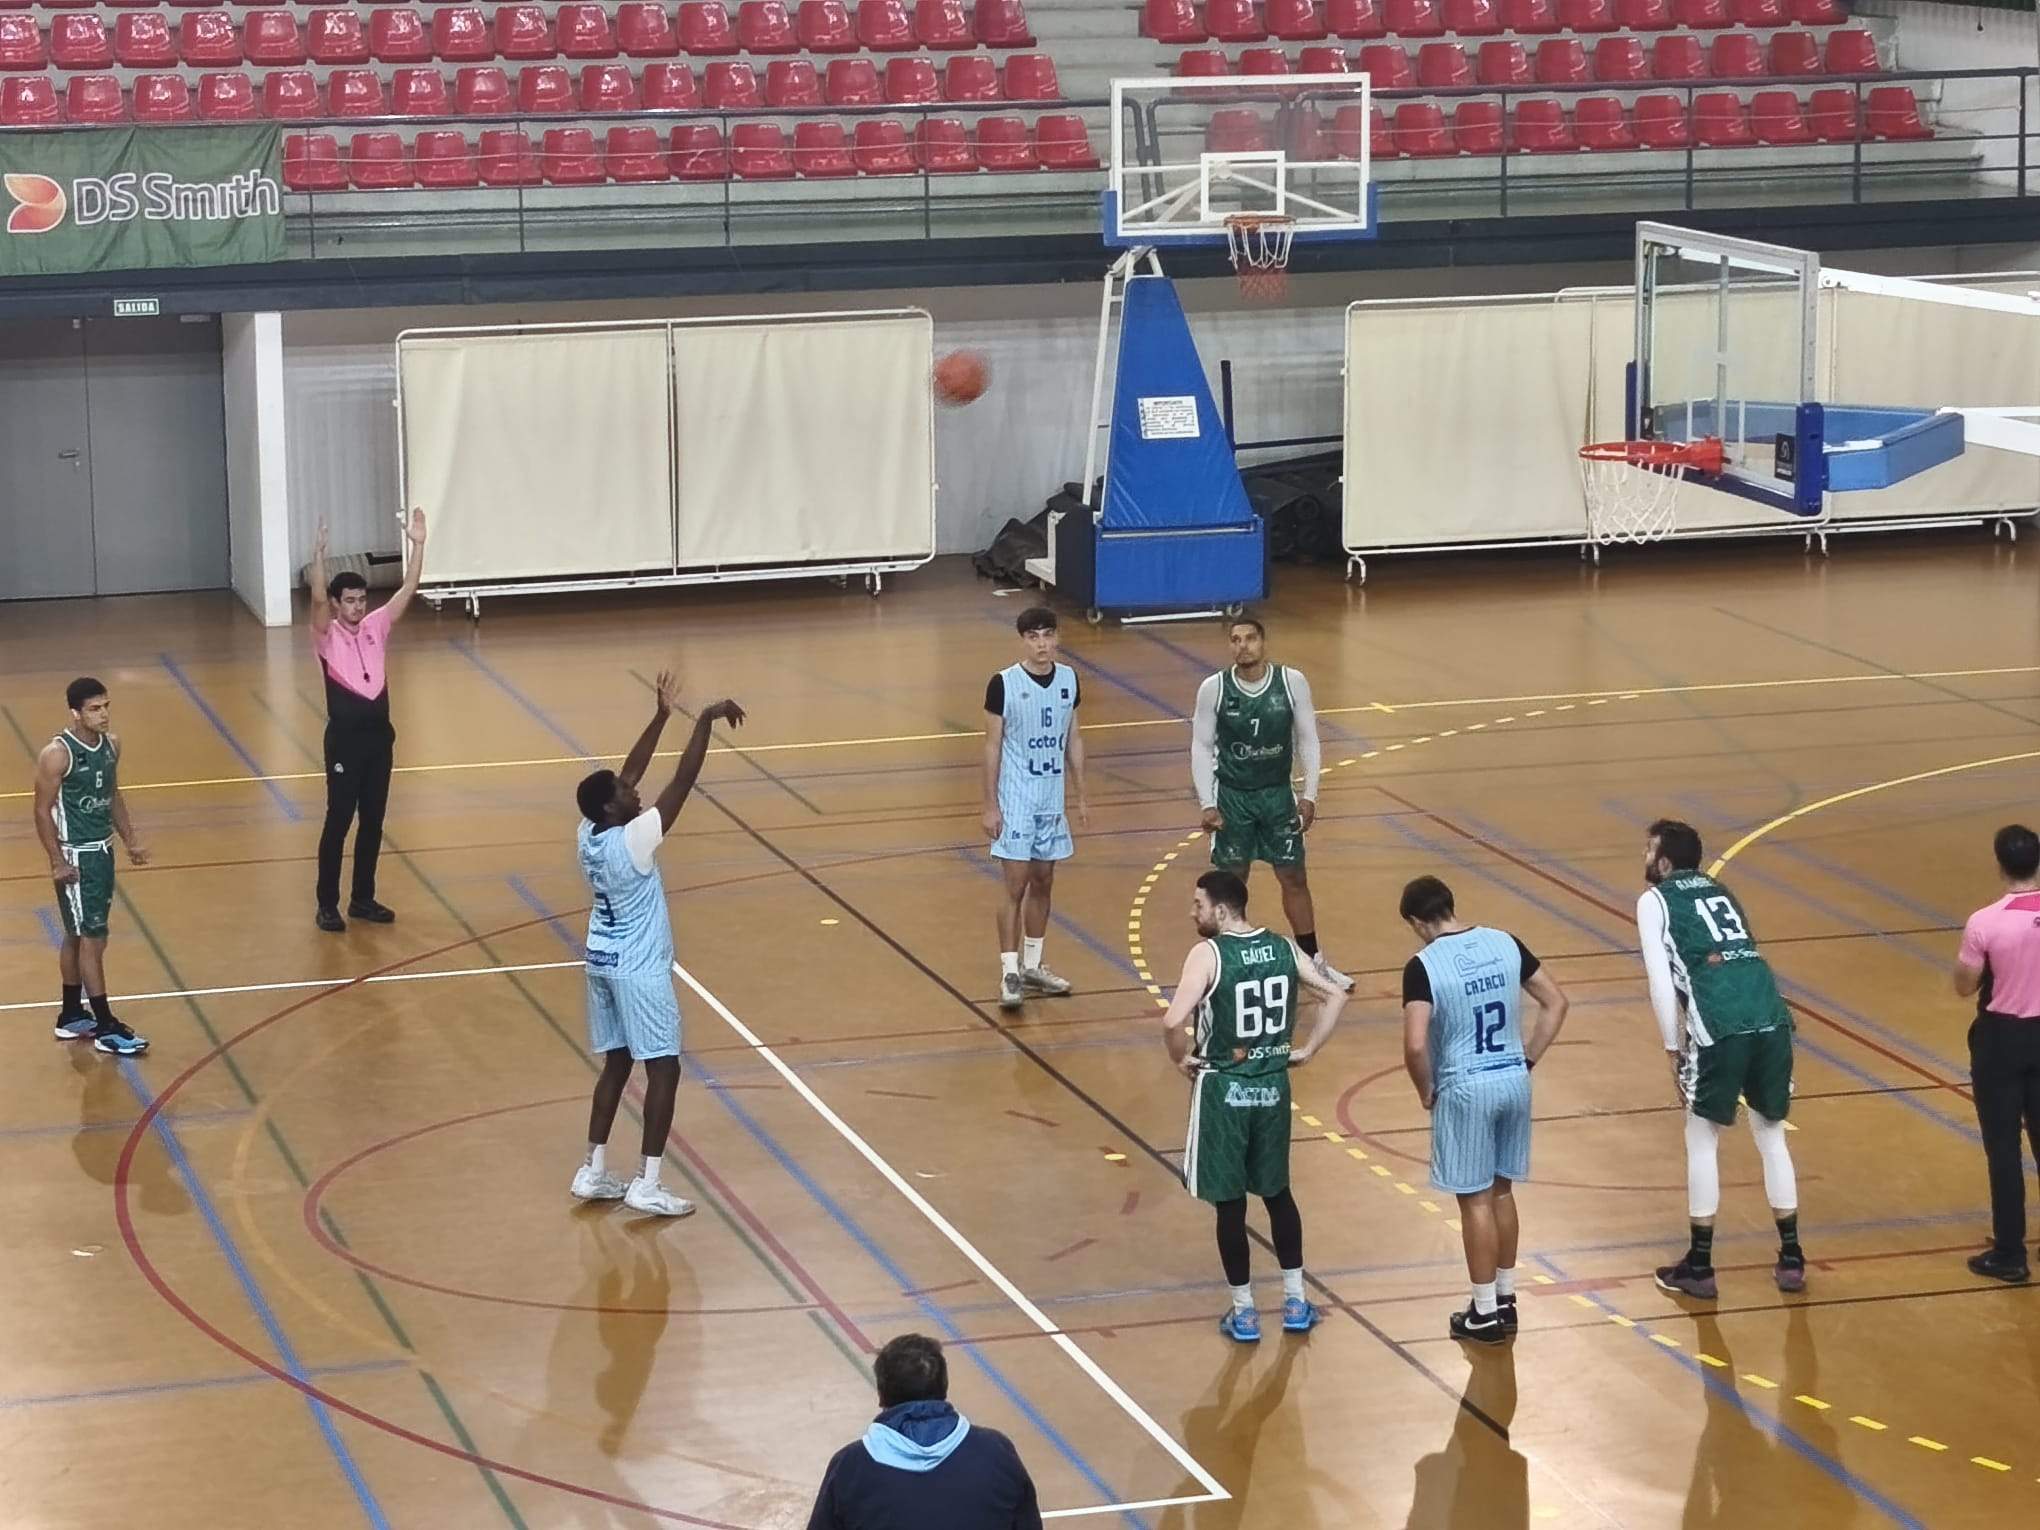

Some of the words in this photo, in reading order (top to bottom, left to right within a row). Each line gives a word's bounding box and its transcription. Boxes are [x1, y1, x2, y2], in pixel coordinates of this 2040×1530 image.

[73, 172, 139, 225] DS
[142, 169, 280, 221] Smith
[117, 302, 156, 313] SALIDA
[1041, 707, 1053, 728] 16
[1250, 718, 1260, 737] 7
[1284, 839, 1294, 853] 7
[1694, 895, 1749, 942] 13
[1464, 973, 1506, 997] CAZACU
[1235, 975, 1289, 1039] 69
[1472, 1000, 1506, 1055] 12
